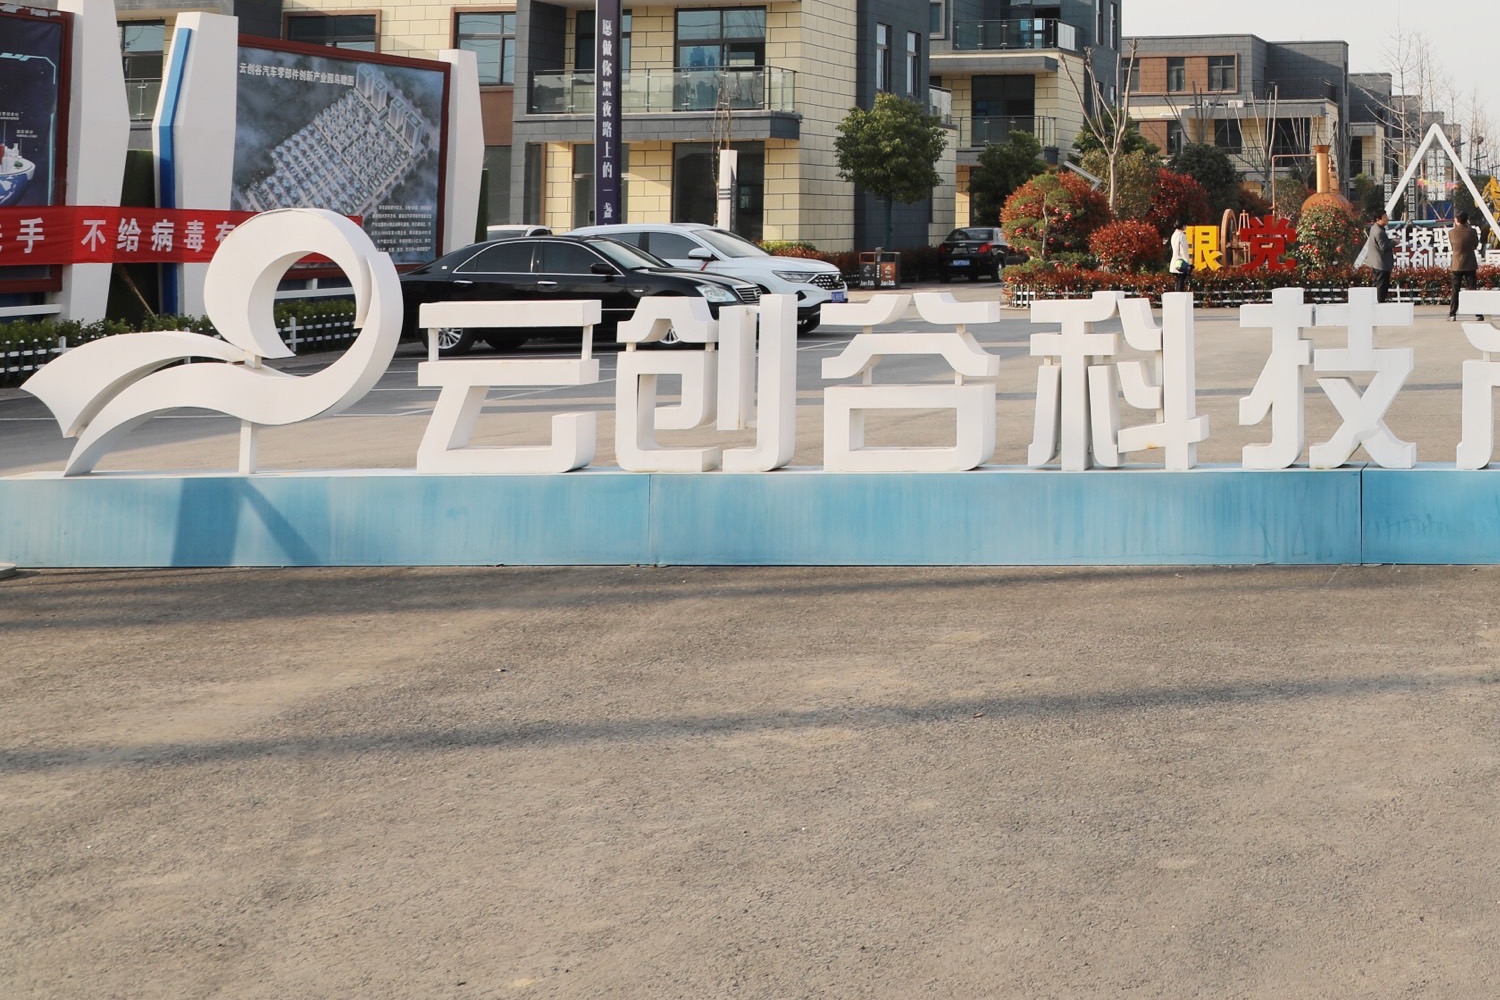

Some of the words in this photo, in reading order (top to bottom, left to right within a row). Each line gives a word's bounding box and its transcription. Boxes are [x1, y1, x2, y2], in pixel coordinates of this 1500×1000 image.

[239, 62, 355, 87] 云创谷汽车零部件创新产业园鸟瞰图
[601, 19, 614, 225] 愿做你黑夜路上的一盏
[0, 217, 45, 254] 手
